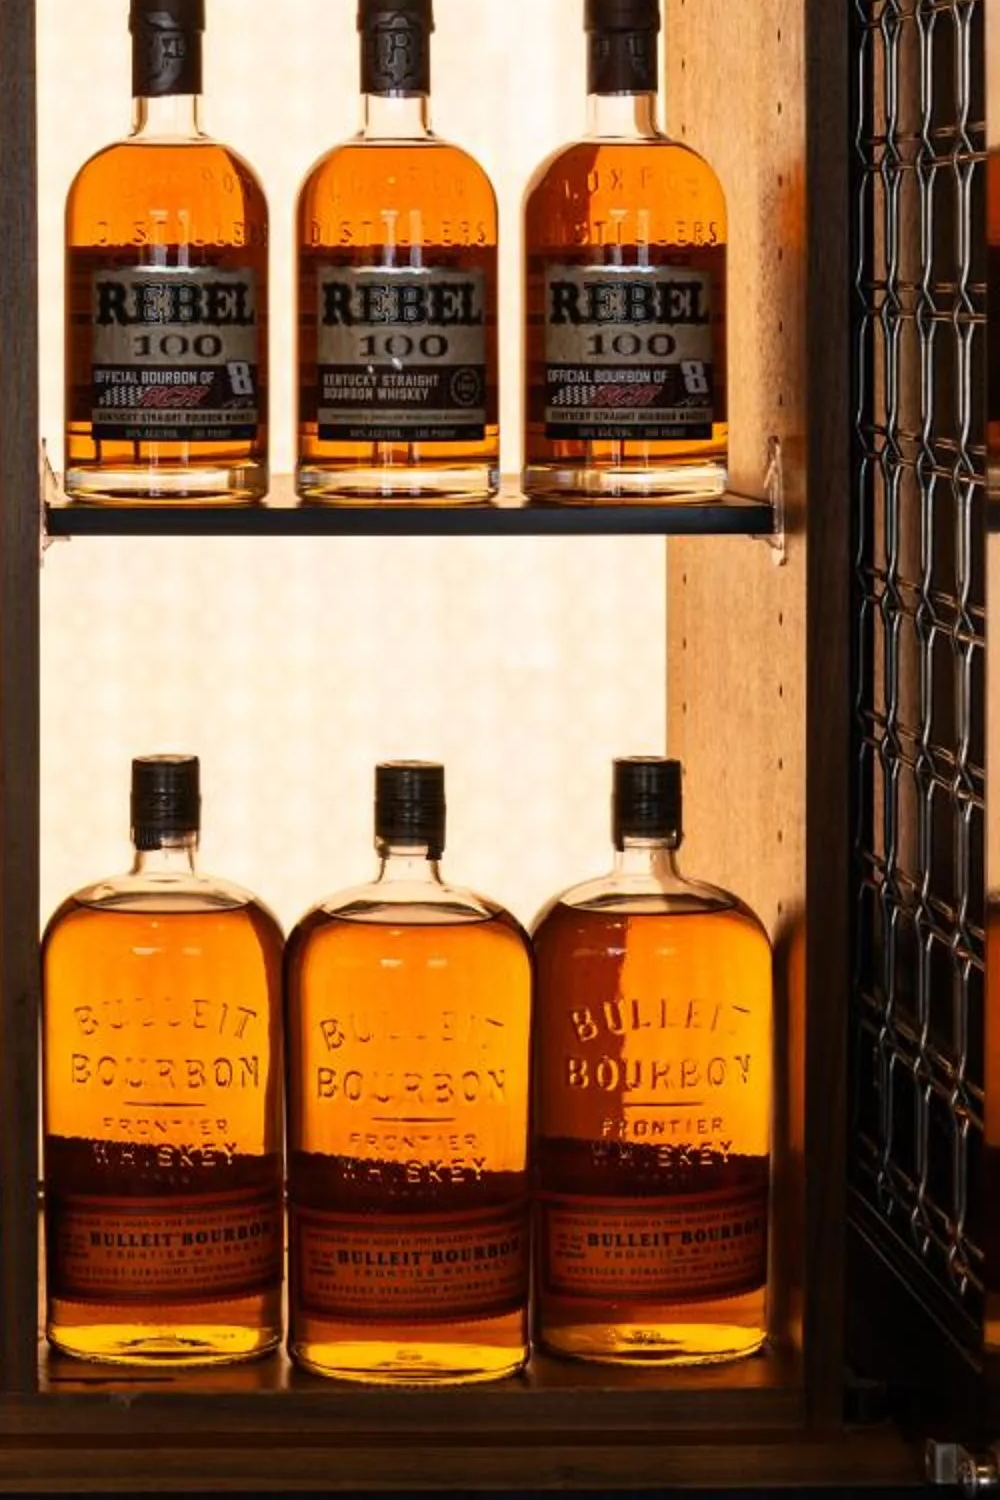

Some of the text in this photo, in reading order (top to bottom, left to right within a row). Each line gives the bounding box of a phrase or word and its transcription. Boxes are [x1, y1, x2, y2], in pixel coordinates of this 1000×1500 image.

[96, 281, 255, 326] REBEL
[321, 282, 483, 326] REBEL
[549, 281, 709, 325] REBEL
[133, 333, 222, 358] 100
[359, 333, 449, 358] 100
[587, 332, 677, 357] 100
[141, 371, 197, 385] BOURBON
[199, 371, 215, 384] OF
[226, 361, 254, 395] 8
[323, 373, 439, 387] KENTUCKY STRAIGHT
[547, 369, 668, 383] OFFICIAL BOURBON OF
[681, 360, 710, 393] 8
[323, 387, 429, 401] BOURBON WHISKEY
[73, 996, 258, 1039] BULLEIT
[572, 998, 751, 1041] BULLEIT
[71, 1054, 260, 1088] BOURBON
[568, 1054, 751, 1092] BOURBON
[317, 1067, 506, 1103] BOURBON
[103, 1117, 229, 1136] FRONTIER
[601, 1117, 724, 1138] FRONTIER
[350, 1133, 477, 1151] FRONTIER
[90, 1230, 173, 1247] BULLEIT
[587, 1232, 671, 1248] BULLEIT
[337, 1249, 421, 1267] BULLEIT
